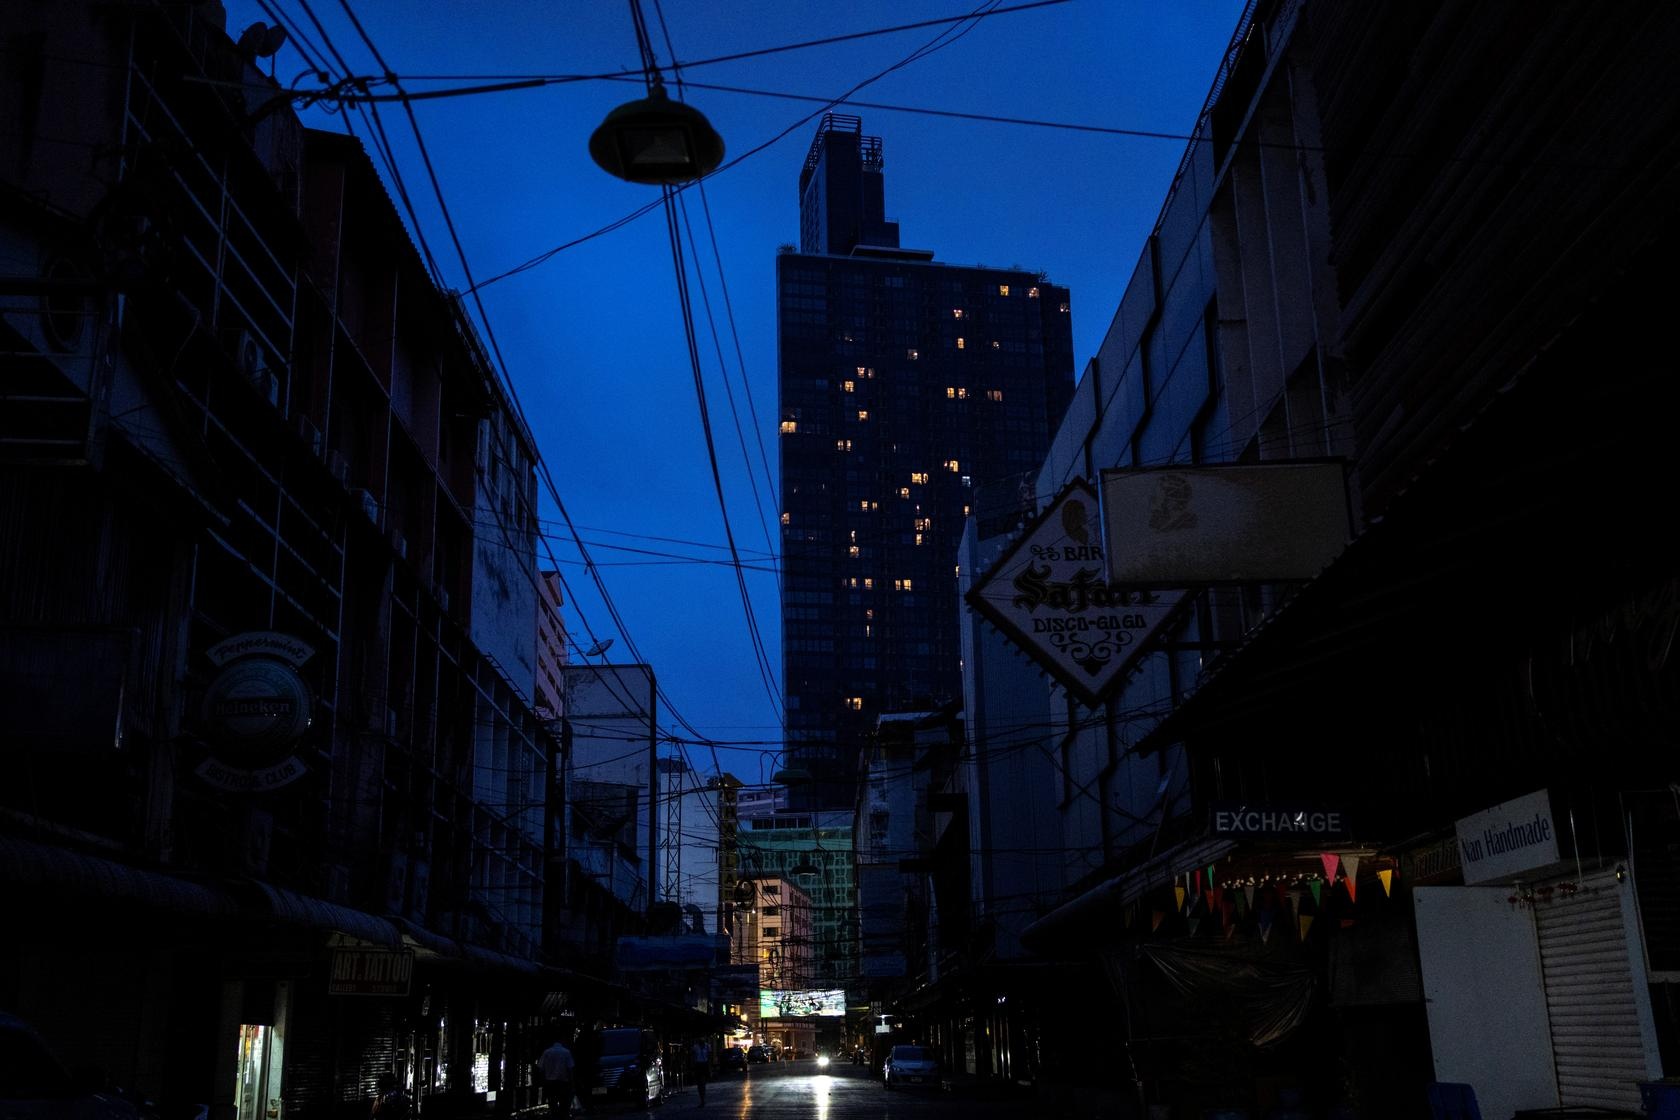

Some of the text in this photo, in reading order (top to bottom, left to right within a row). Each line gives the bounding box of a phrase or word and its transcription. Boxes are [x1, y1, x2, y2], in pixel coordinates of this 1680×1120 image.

[1064, 546, 1103, 561] BAR
[215, 699, 290, 716] Heineken
[265, 763, 296, 785] CLUB
[1216, 811, 1342, 832] EXCHANGE
[334, 952, 361, 980] ART
[364, 952, 410, 982] TATTOO
